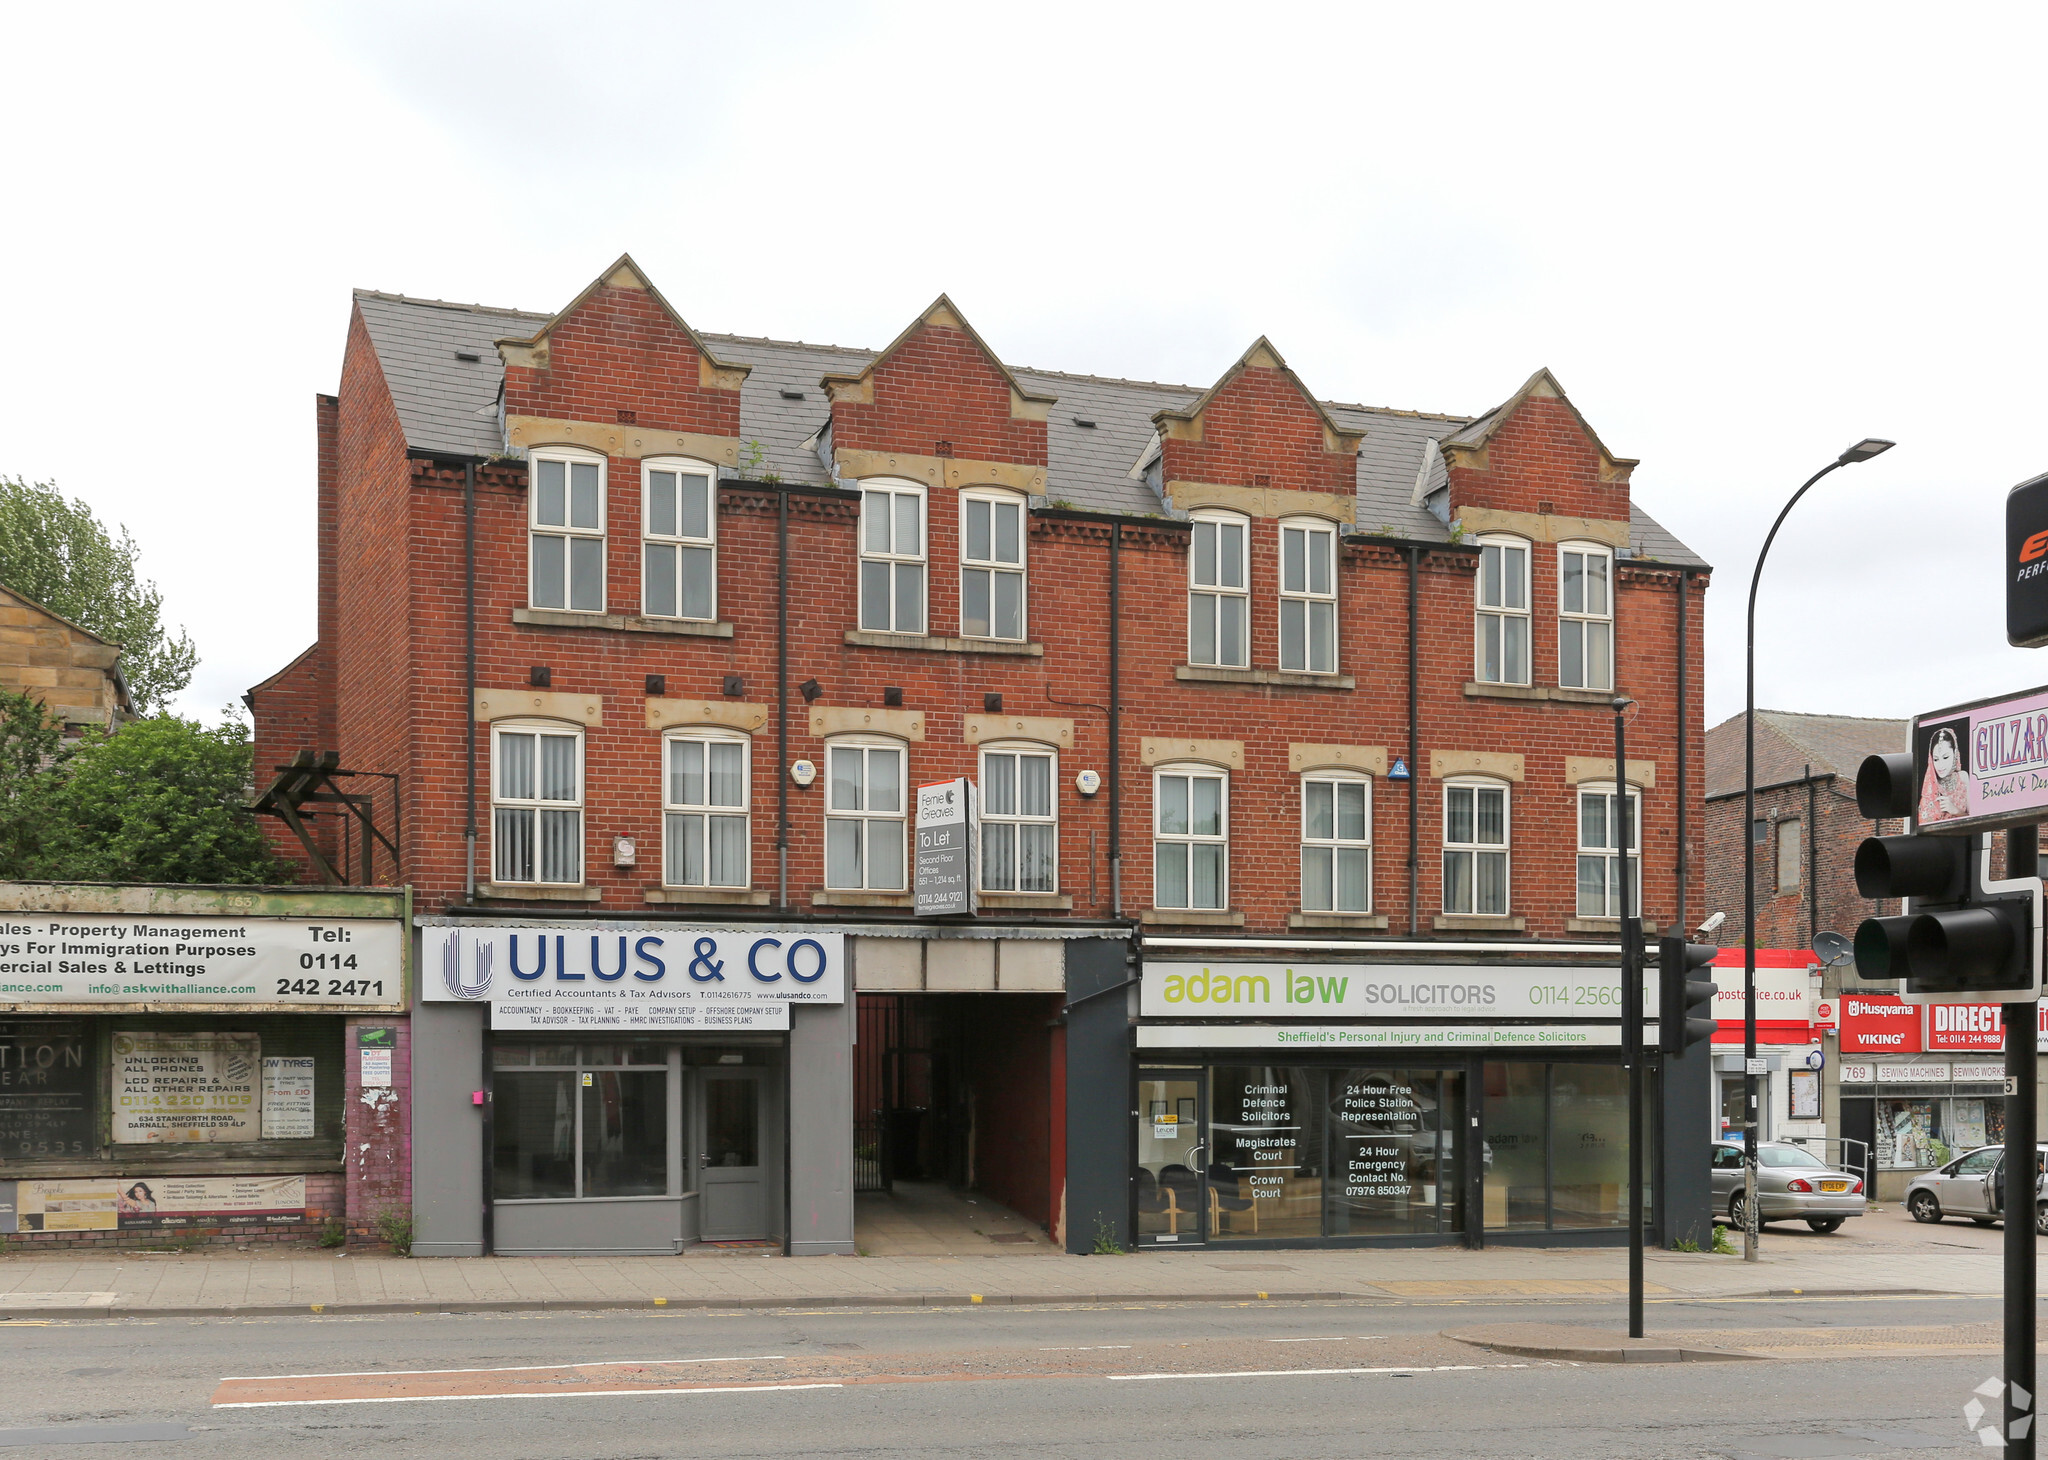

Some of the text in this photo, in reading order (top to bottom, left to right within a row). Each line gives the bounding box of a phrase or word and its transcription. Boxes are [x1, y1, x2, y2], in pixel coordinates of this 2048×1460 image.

[2017, 560, 2048, 582] PERF
[1982, 777, 2014, 800] Bridal
[922, 807, 954, 820] Greaves
[920, 830, 950, 847] To Let
[919, 854, 953, 865] Second Floor
[919, 866, 939, 875] Offices
[918, 891, 962, 904] 0114 244 9121
[50, 923, 128, 939] Property
[133, 924, 246, 940] Management
[308, 926, 351, 943] Tel:
[27, 942, 56, 954] For
[62, 942, 169, 958] Immigration
[175, 943, 256, 958] Purposes
[300, 953, 358, 970] 0114
[509, 934, 827, 984] ULUS & CO
[58, 961, 108, 974] Sales
[114, 961, 127, 974] &
[134, 961, 206, 977] Lettings
[276, 978, 383, 996] 242 2471
[1164, 968, 1270, 1004] adam
[1286, 969, 1349, 1004] law
[1365, 983, 1496, 1004] SOLICITORS
[1529, 986, 1569, 1005] 0114
[508, 989, 551, 998] Certified
[555, 989, 617, 998] Accountants
[620, 990, 627, 998] &
[630, 990, 646, 998] Tax
[649, 990, 691, 999] Advisors
[1718, 988, 1802, 1002] postoice.co.uk
[499, 1006, 783, 1015] ACCOUNTANCY BOOKKEEPING VAT PAYE COMPANY SETUP OFFSHORE COMPANY SETUP
[1860, 1002, 1914, 1017] Husqvarna
[530, 1016, 753, 1024] TAX ADVISOR TAX PLANNING HMRC INVESTIGATIONS BUSINESS PLANS
[1935, 1006, 2002, 1032] DIRECT
[1278, 1031, 1587, 1044] Sheffield's Personal Injury and Criminal Defence Solicitors
[1936, 1034, 2001, 1043] Tel: 0114 244 9888
[263, 1060, 313, 1068] JW TYRES
[1845, 1067, 1866, 1079] 769
[1881, 1067, 1944, 1078] SEWING MACHINES
[1953, 1067, 1980, 1077] SEWING
[1244, 1084, 1287, 1094] Criminal
[1346, 1085, 1412, 1096] 24 Hour Free
[2005, 1078, 2013, 1093] 5
[120, 1095, 252, 1106] 0114 220 1109
[1243, 1098, 1286, 1108] Defence
[1345, 1098, 1413, 1108] Police Station
[1242, 1111, 1290, 1121] Solicitors
[1341, 1111, 1417, 1123] Representation
[1236, 1138, 1296, 1149] Magistrates
[1253, 1151, 1282, 1161] Court
[1359, 1147, 1399, 1157] 24 Hour
[1349, 1160, 1406, 1172] Emergency
[1249, 1176, 1284, 1185] Crown
[1349, 1173, 1406, 1183] Contact No.
[1252, 1188, 1281, 1198] Court
[1346, 1186, 1412, 1196] 07976 850347
